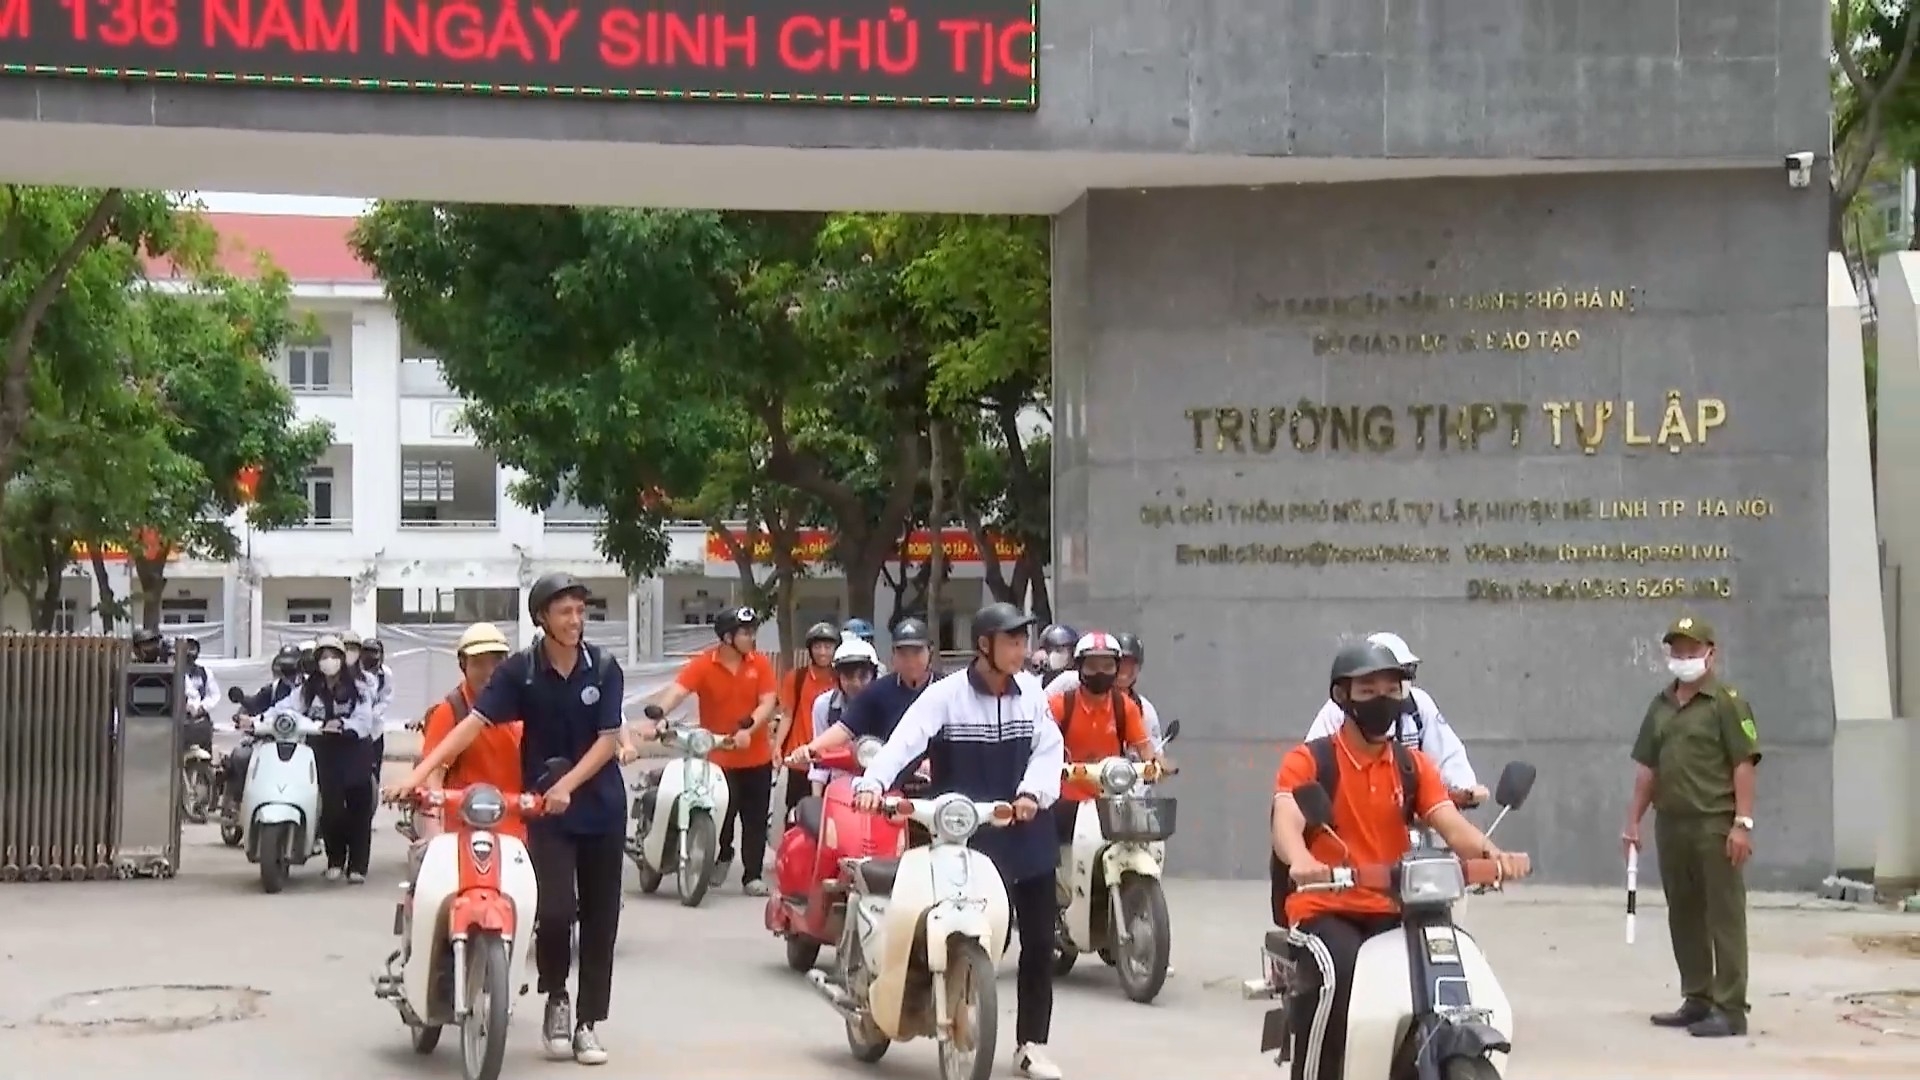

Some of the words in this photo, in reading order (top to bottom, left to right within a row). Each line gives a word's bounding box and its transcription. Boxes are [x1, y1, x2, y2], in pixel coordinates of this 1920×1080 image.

[61, 0, 179, 46] 136
[600, 8, 756, 67] SINH
[779, 8, 919, 73] CHỦ
[1185, 396, 1394, 454] TRƯỜNG
[1407, 402, 1528, 453] THPT
[1543, 399, 1613, 455] TỰ
[1626, 390, 1726, 454] LẬP
[1600, 500, 1648, 521] LINH
